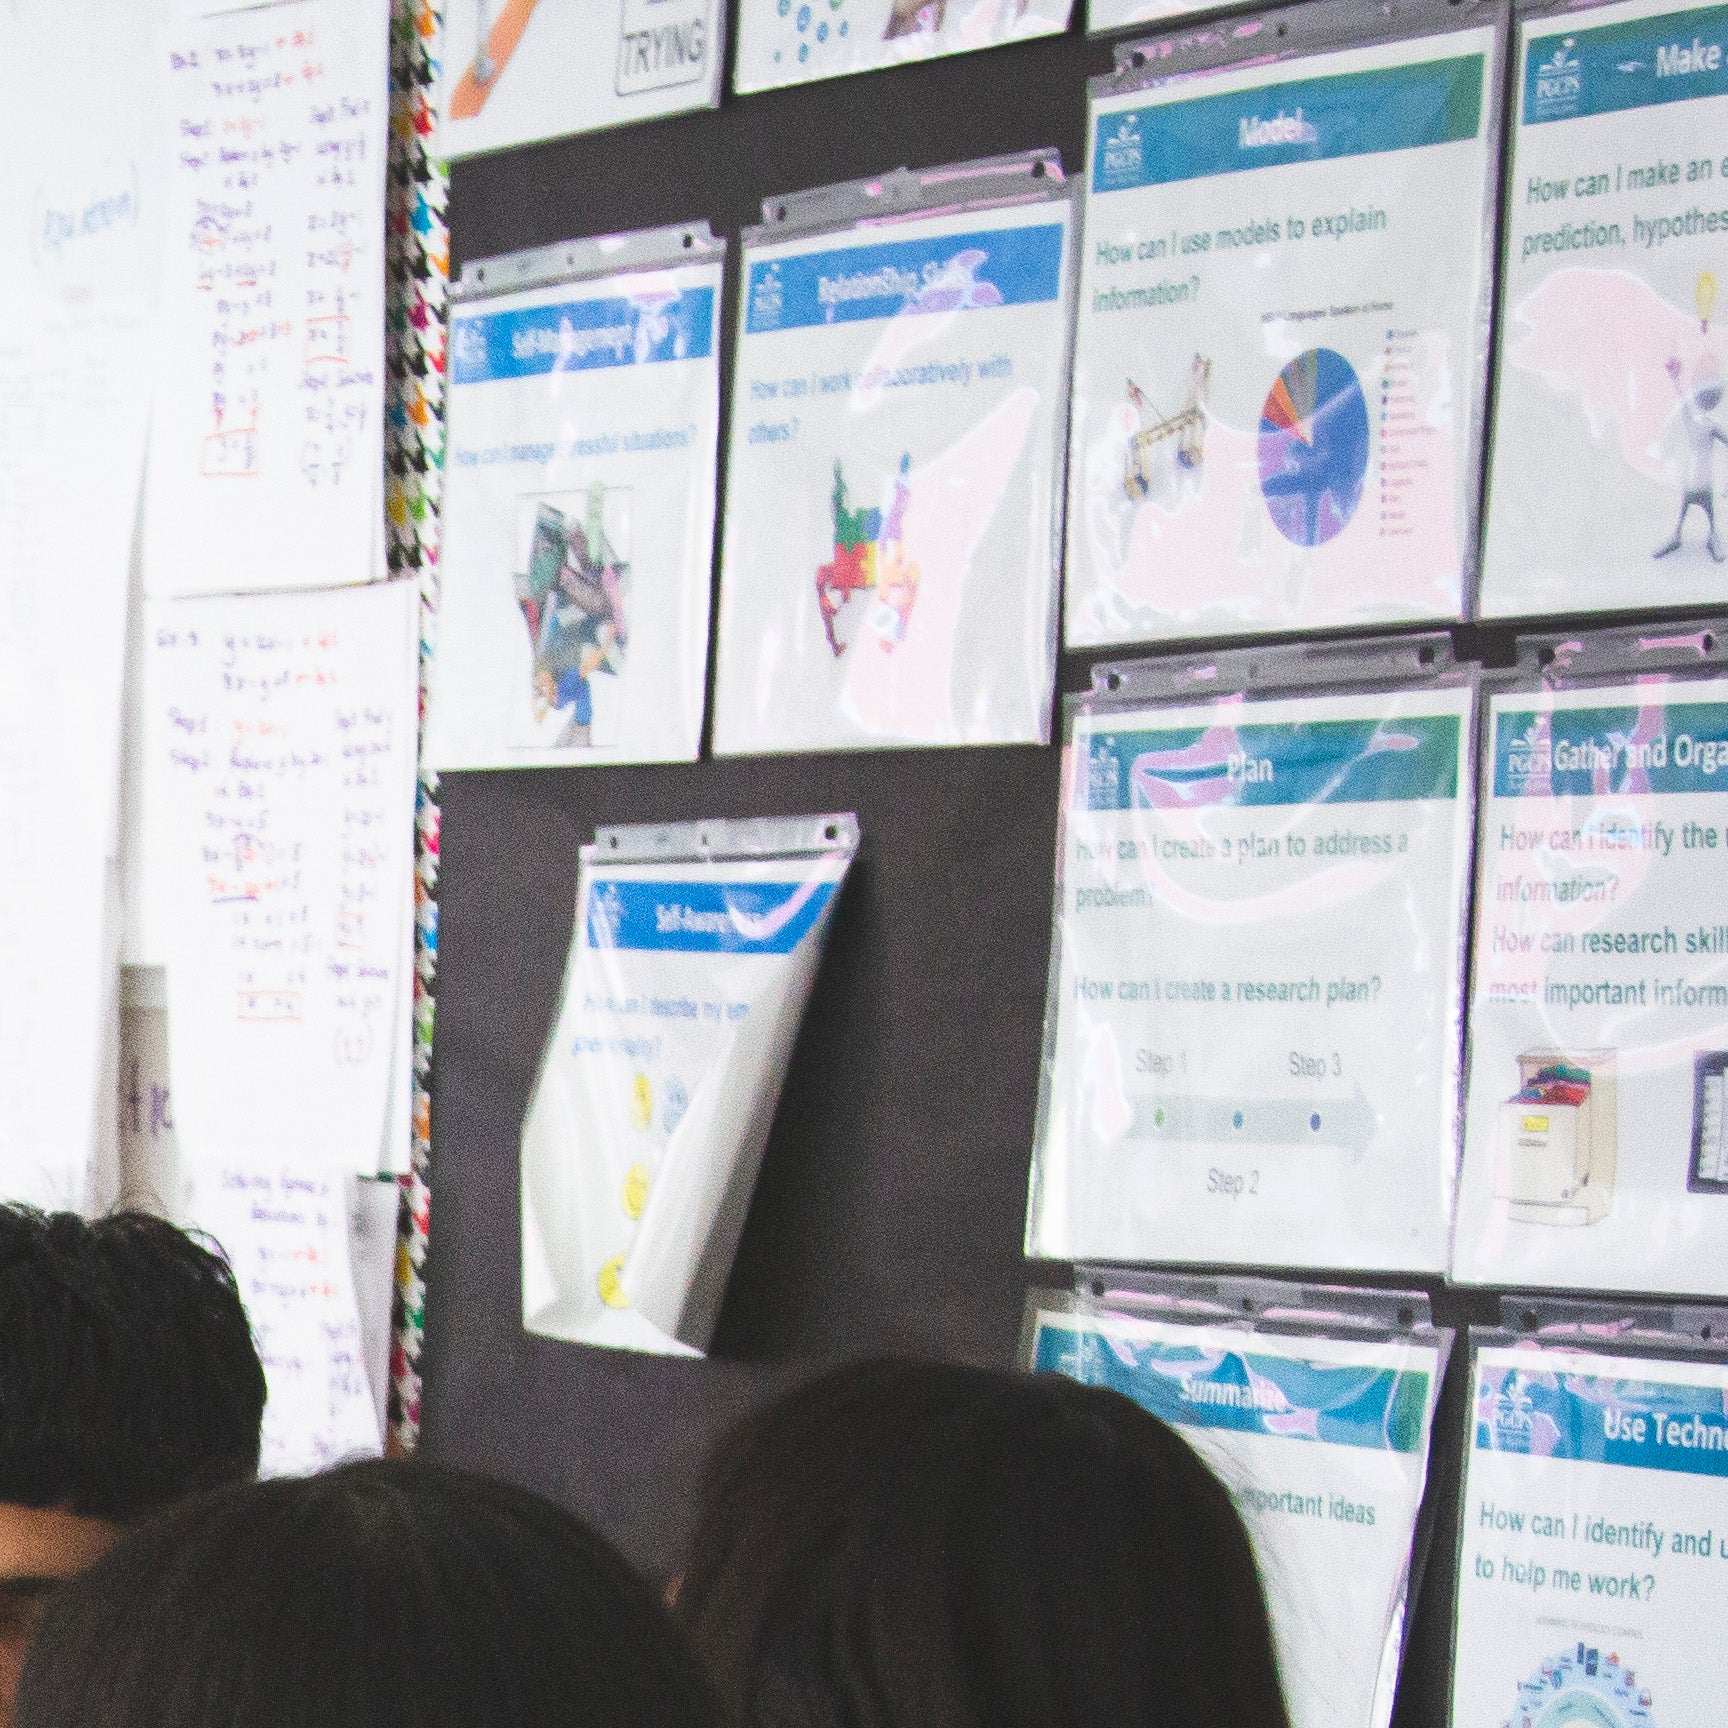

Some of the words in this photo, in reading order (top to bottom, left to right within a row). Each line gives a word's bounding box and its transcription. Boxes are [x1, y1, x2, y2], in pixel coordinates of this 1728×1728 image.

[623, 18, 704, 77] TRYING
[1655, 36, 1722, 79] Make
[1525, 176, 1571, 205] How
[1573, 172, 1611, 199] can
[1626, 159, 1681, 190] make
[1685, 158, 1714, 184] an
[1095, 235, 1132, 266] How
[1137, 233, 1167, 260] can
[1181, 225, 1211, 252] use
[1216, 214, 1281, 249] models
[1286, 214, 1306, 241] to
[1312, 205, 1389, 242] explain
[1521, 219, 1626, 263] prediction,
[1092, 275, 1201, 313] information?
[1226, 751, 1274, 784] Plan
[1554, 736, 1620, 774] Gather
[1624, 735, 1669, 770] and
[1237, 831, 1282, 866] plan
[1285, 832, 1307, 858] to
[1312, 827, 1392, 859] address
[1499, 822, 1543, 852] How
[1548, 824, 1582, 852] can
[1682, 819, 1718, 850] the
[1495, 873, 1621, 903] information?
[1492, 926, 1533, 954] How
[1539, 927, 1576, 955] can
[1581, 924, 1678, 955] research
[1072, 975, 1113, 1004] How
[1117, 978, 1150, 1002] can
[1164, 978, 1218, 1002] create
[1235, 974, 1321, 1003] research
[1326, 973, 1383, 1009] plan?
[1544, 976, 1655, 1012] important
[1135, 1047, 1176, 1081] Step
[1287, 1050, 1328, 1082] Step
[1330, 1051, 1344, 1078] 3
[1206, 1166, 1247, 1200] Step
[1248, 1170, 1261, 1196] 2
[1603, 1408, 1647, 1442] Use
[1328, 1492, 1377, 1527] ideas
[1479, 1501, 1526, 1532] How
[1530, 1513, 1567, 1539] can
[1571, 1513, 1579, 1538] I
[1585, 1514, 1665, 1559] identify
[1670, 1529, 1713, 1559] and
[1474, 1553, 1495, 1580] to
[1552, 1566, 1582, 1591] me
[1587, 1573, 1656, 1602] work?
